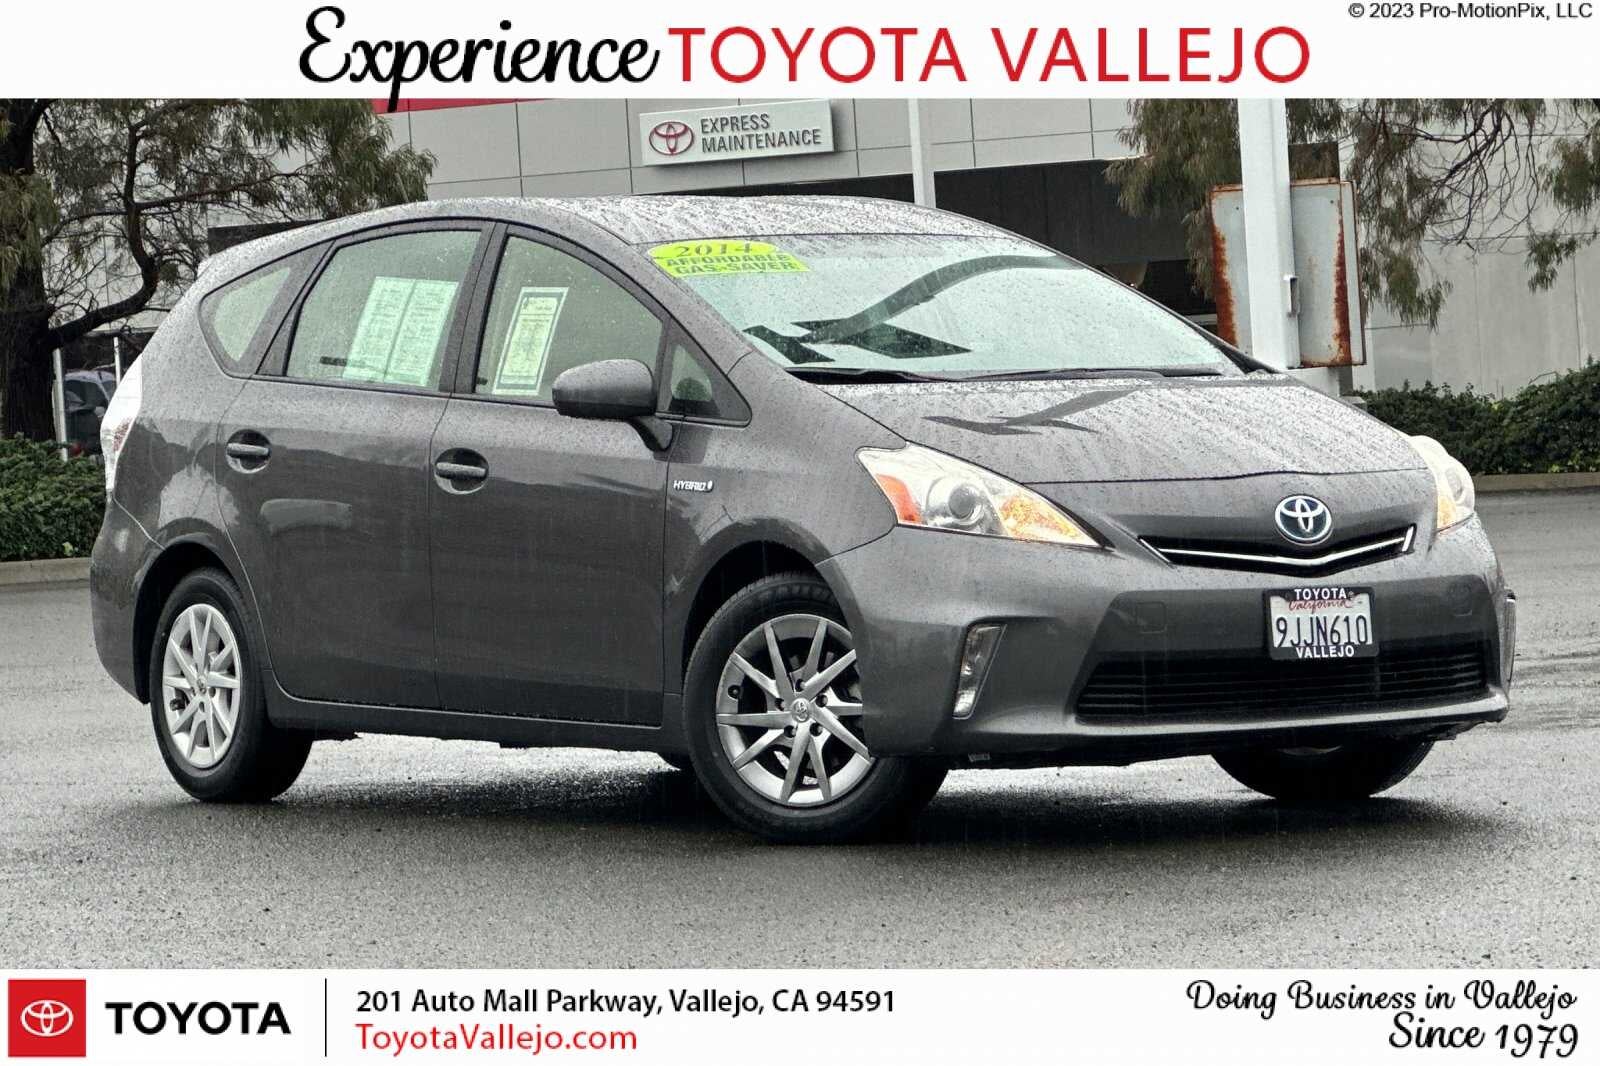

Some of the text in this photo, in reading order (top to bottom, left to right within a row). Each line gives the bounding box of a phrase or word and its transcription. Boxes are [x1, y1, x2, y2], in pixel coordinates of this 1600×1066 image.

[700, 114, 770, 134] EXPRESS
[701, 128, 821, 153] MAINTENANCE
[676, 243, 752, 257] 2014
[1294, 588, 1347, 600] TOYOTA
[1276, 615, 1368, 647] 9JJN610
[1296, 646, 1354, 658] VALLEJO
